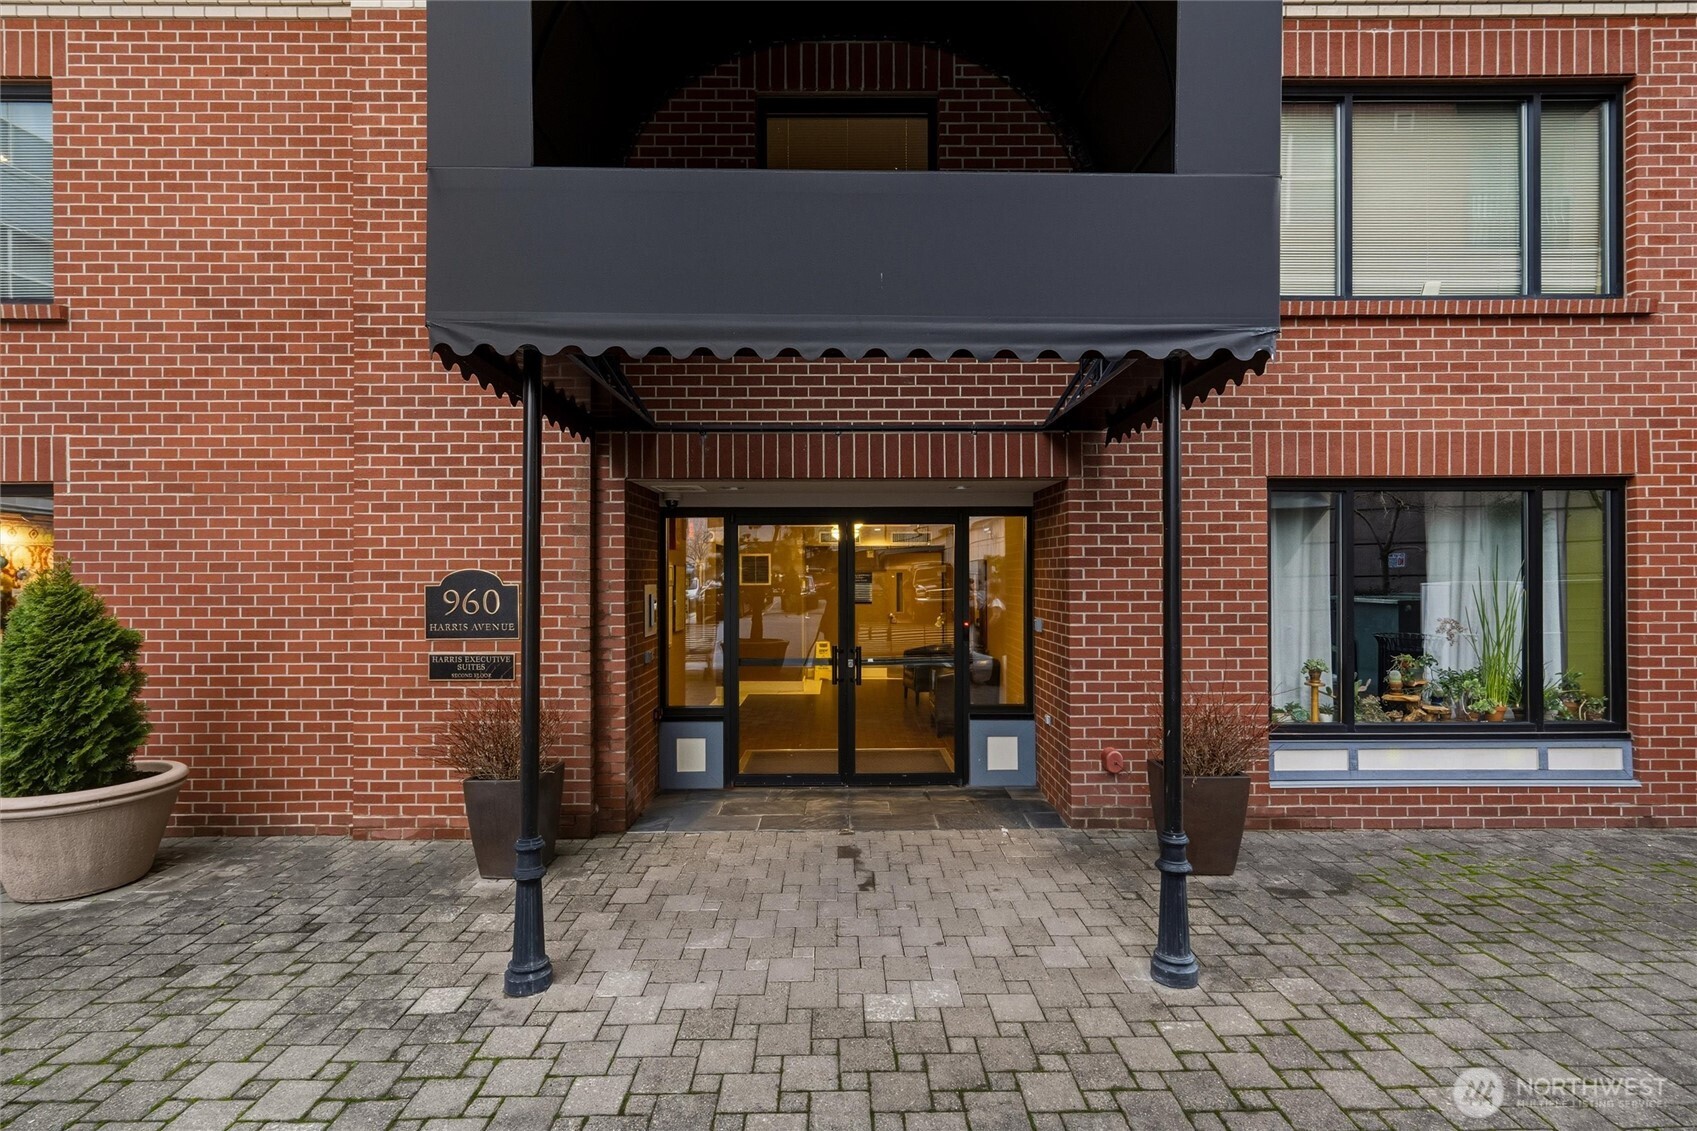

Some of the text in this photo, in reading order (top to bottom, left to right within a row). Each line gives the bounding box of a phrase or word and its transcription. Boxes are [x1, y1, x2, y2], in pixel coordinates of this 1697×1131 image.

[443, 588, 501, 616] 960
[429, 623, 515, 632] HARRIS AVENUE
